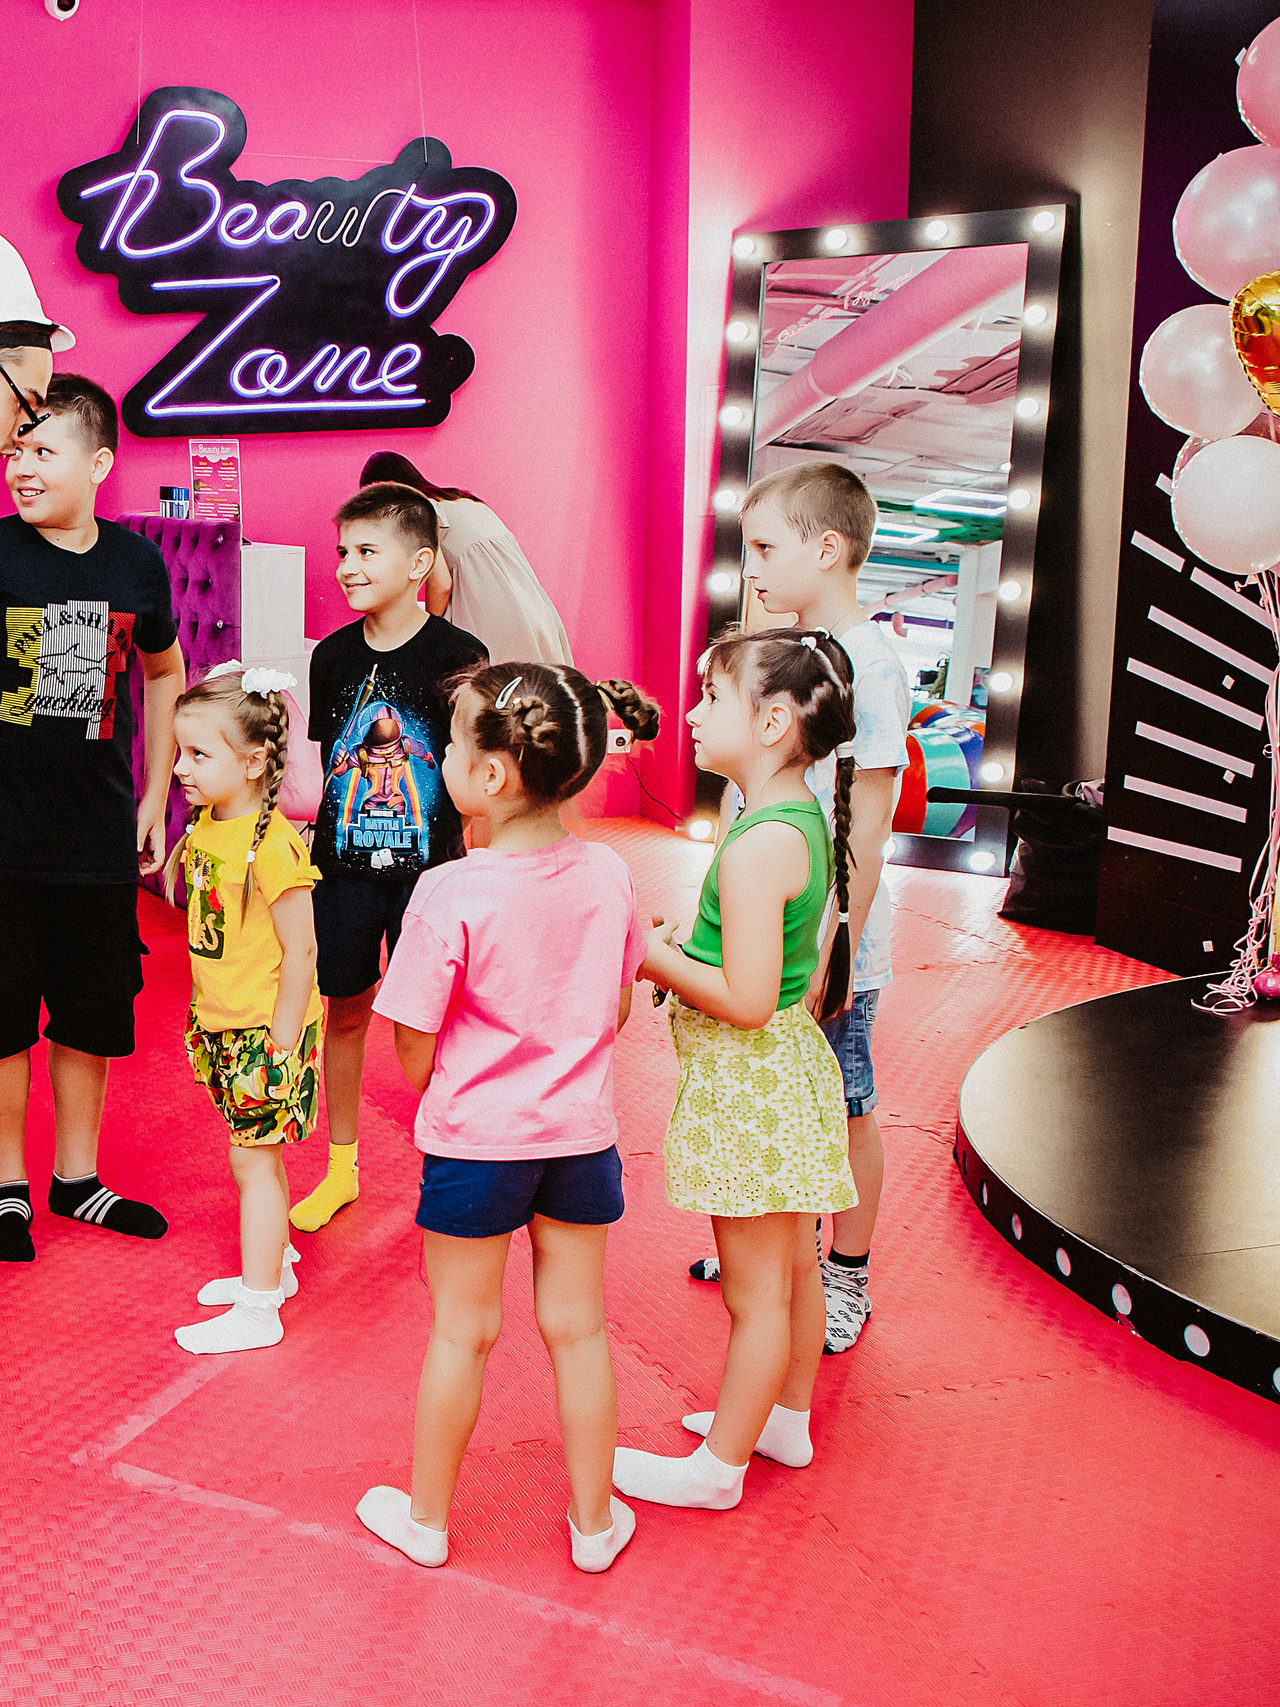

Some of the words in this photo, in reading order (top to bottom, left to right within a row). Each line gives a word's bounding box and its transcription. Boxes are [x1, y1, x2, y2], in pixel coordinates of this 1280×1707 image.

[79, 108, 497, 317] Beauty
[145, 274, 427, 417] Zone
[198, 444, 219, 455] Beauty
[220, 445, 231, 454] bar
[14, 616, 57, 655] PAUL
[59, 610, 73, 626] &
[9, 683, 117, 723] yachting
[353, 829, 412, 848] ROYALE
[364, 818, 399, 830] BATTLE
